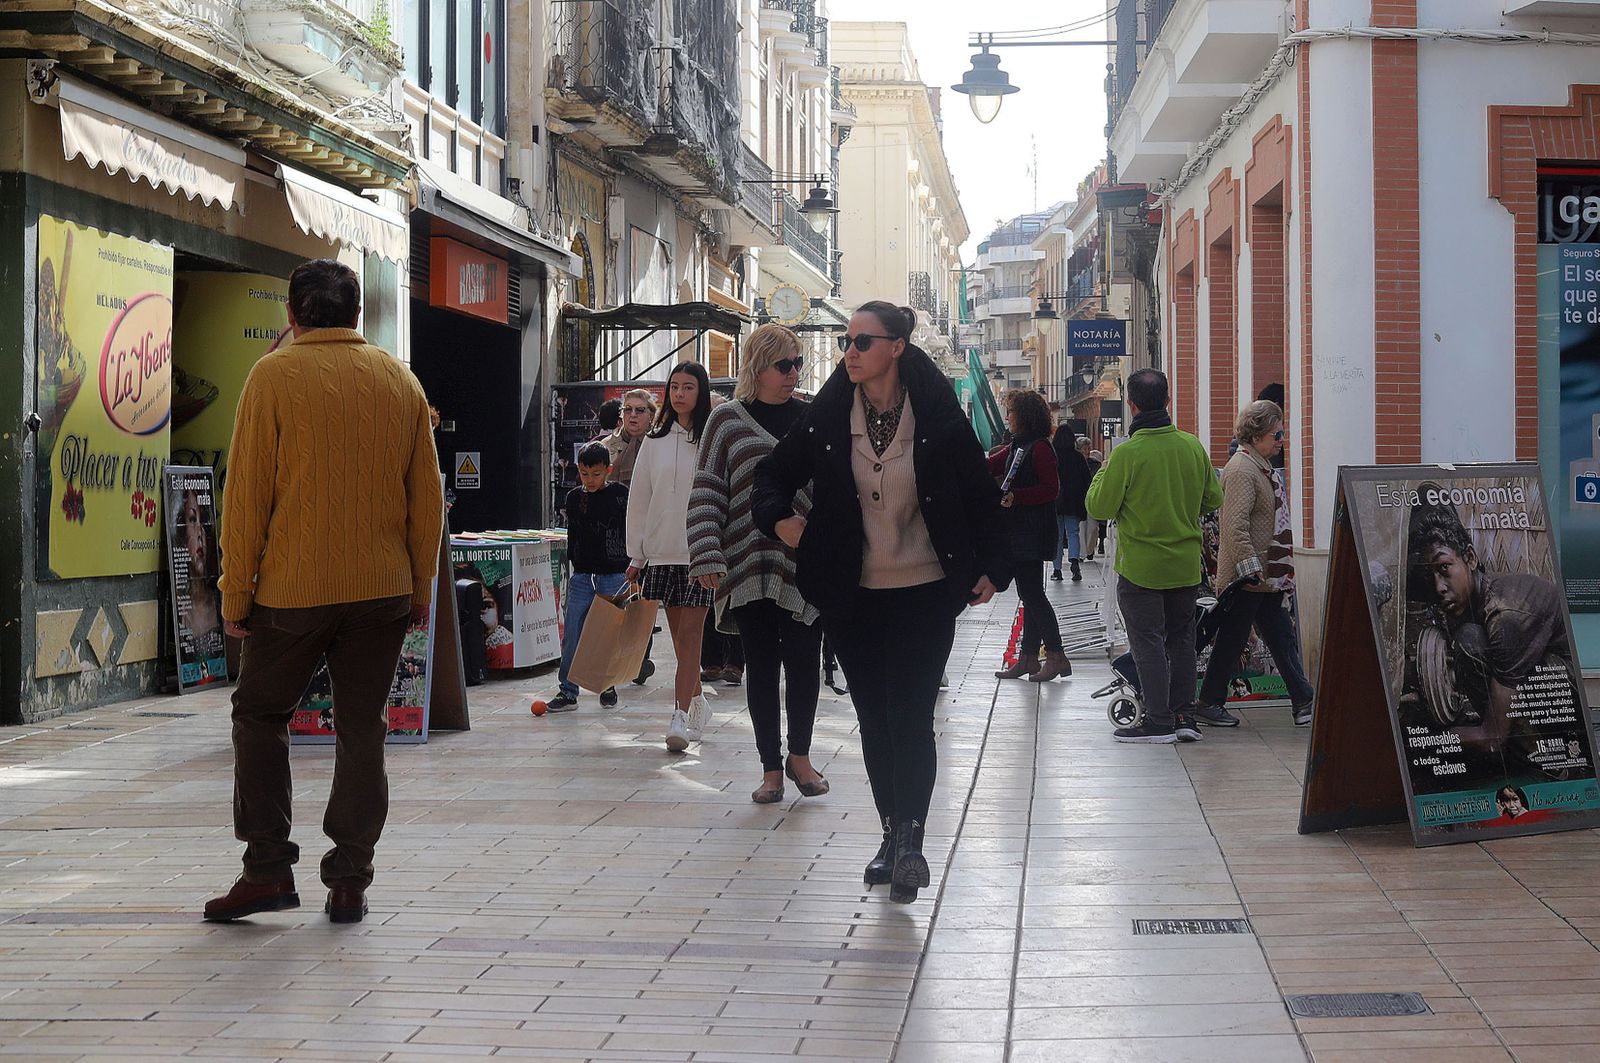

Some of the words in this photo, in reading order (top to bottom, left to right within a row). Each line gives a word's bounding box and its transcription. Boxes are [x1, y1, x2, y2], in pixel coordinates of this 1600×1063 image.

[1563, 248, 1593, 259] Seguro
[1564, 264, 1580, 282] El
[96, 294, 127, 310] HELADOS
[1564, 289, 1598, 307] que
[1564, 307, 1582, 324] te
[1073, 328, 1121, 339] NOTARÍA
[60, 434, 120, 489] Placer
[122, 455, 133, 489] a
[136, 449, 158, 490] tus
[171, 475, 184, 490] Esta
[184, 475, 210, 490] economía
[197, 494, 211, 506] mata
[1375, 484, 1422, 507] Esta
[1426, 482, 1526, 507] economía
[1480, 508, 1530, 530] mata
[1528, 673, 1568, 682] sometimiento
[1534, 681, 1570, 690] trabajadores
[1547, 689, 1572, 698] sociedad
[1510, 701, 1529, 709] donde
[1529, 699, 1552, 708] muchos
[1552, 698, 1574, 706] adultos
[1506, 710, 1522, 718] están
[1531, 710, 1545, 718] paro
[1560, 706, 1576, 714] niños
[1406, 726, 1429, 735] Todos
[1408, 731, 1461, 749] responsables
[1536, 740, 1546, 753] 16
[1442, 745, 1463, 753] todos
[1420, 756, 1441, 765] todos
[1433, 761, 1467, 776] esclavos
[1422, 804, 1453, 818] JUSTICIA
